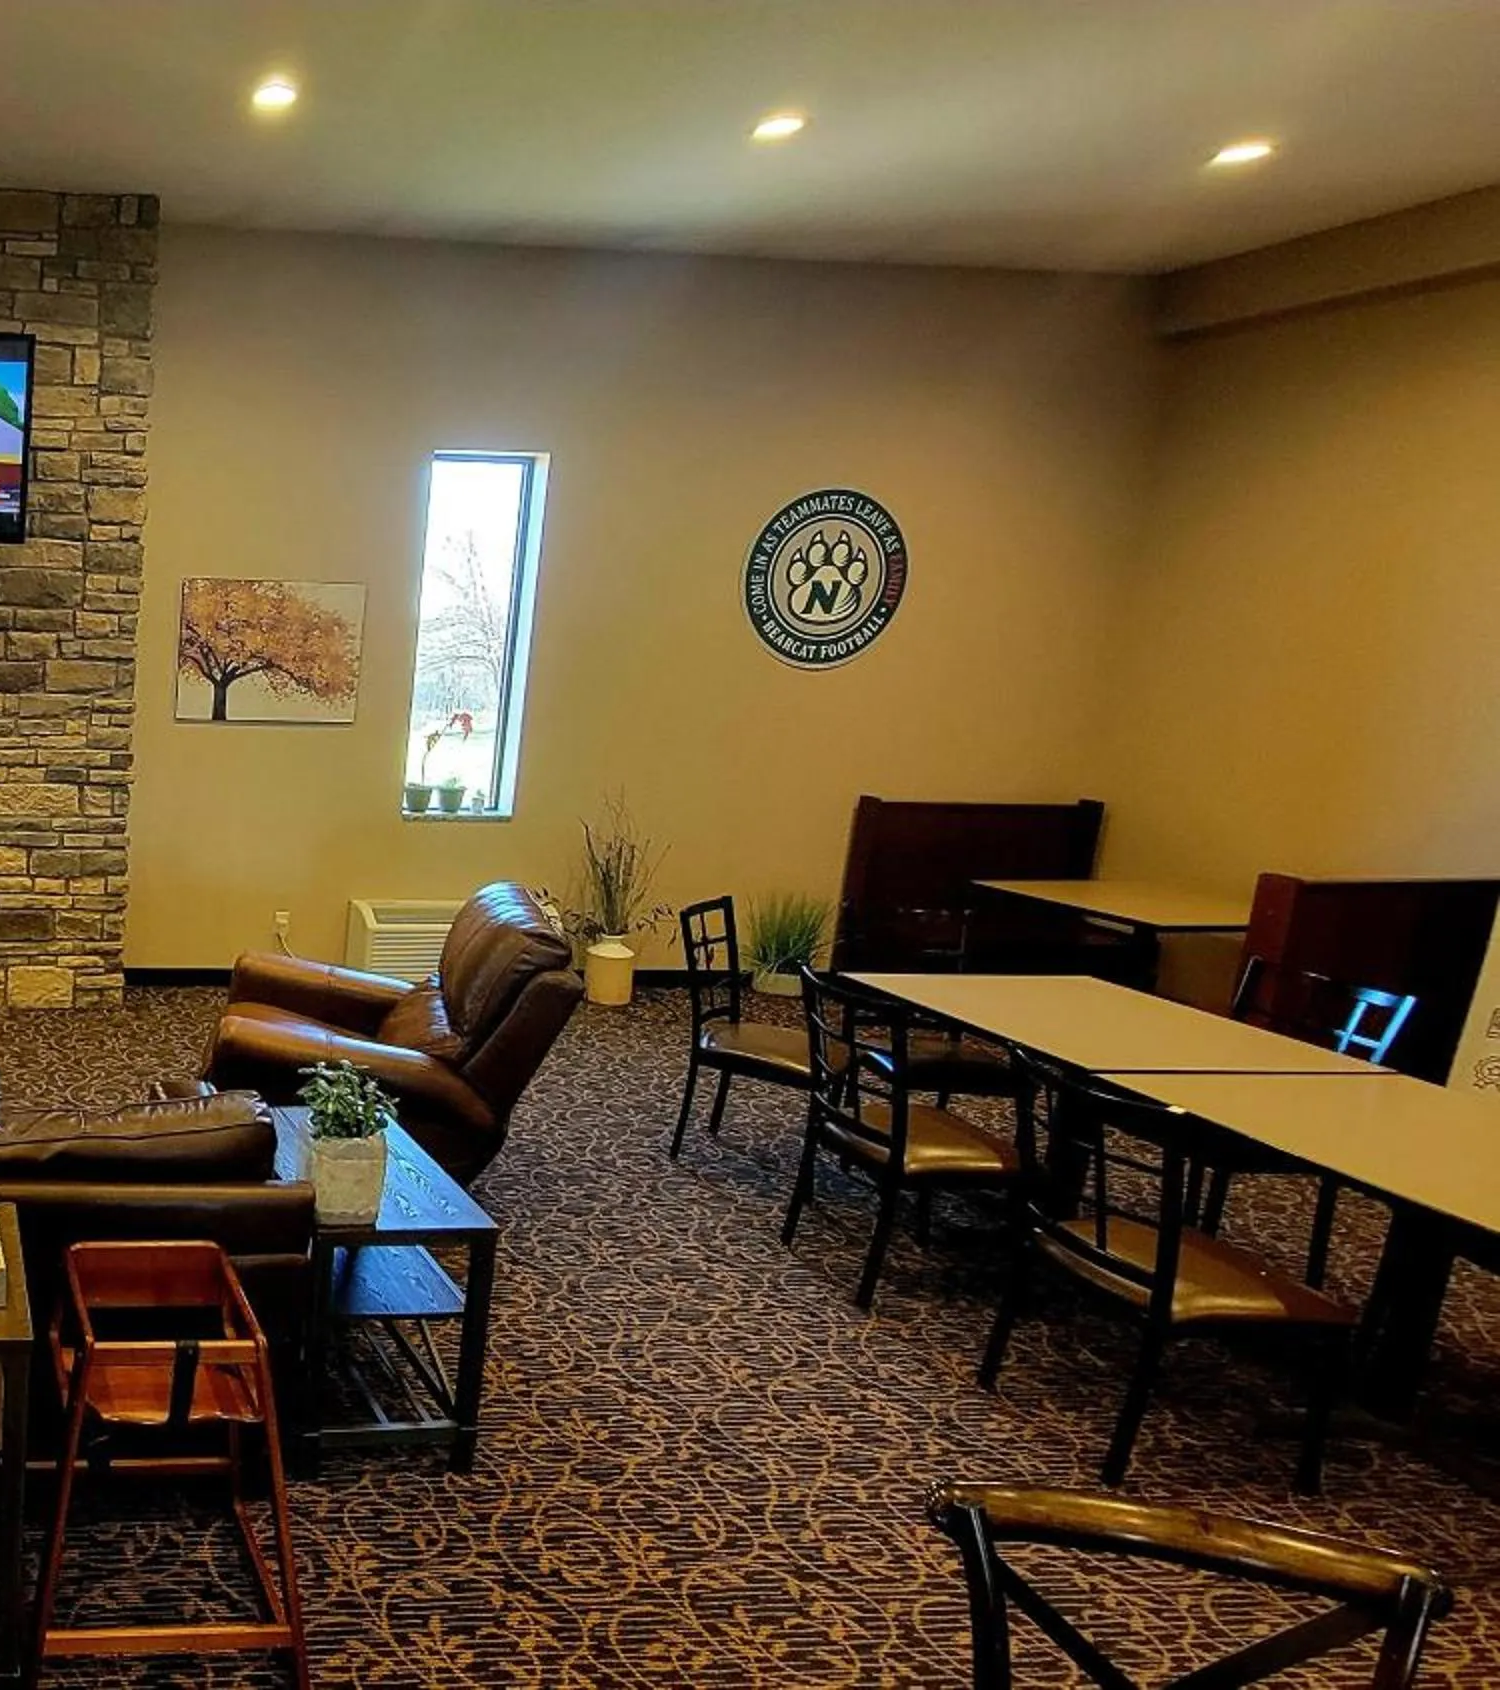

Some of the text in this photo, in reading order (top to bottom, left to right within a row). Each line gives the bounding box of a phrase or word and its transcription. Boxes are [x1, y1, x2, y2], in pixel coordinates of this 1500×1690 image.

[773, 495, 855, 535] TEAMMATES
[855, 500, 892, 536] LEAVE
[761, 532, 779, 552] AS
[883, 535, 901, 553] AS
[752, 553, 770, 571] IN
[751, 573, 767, 615] COME
[800, 580, 842, 615] N
[762, 616, 885, 659] BEARCAT FOOTBALL
